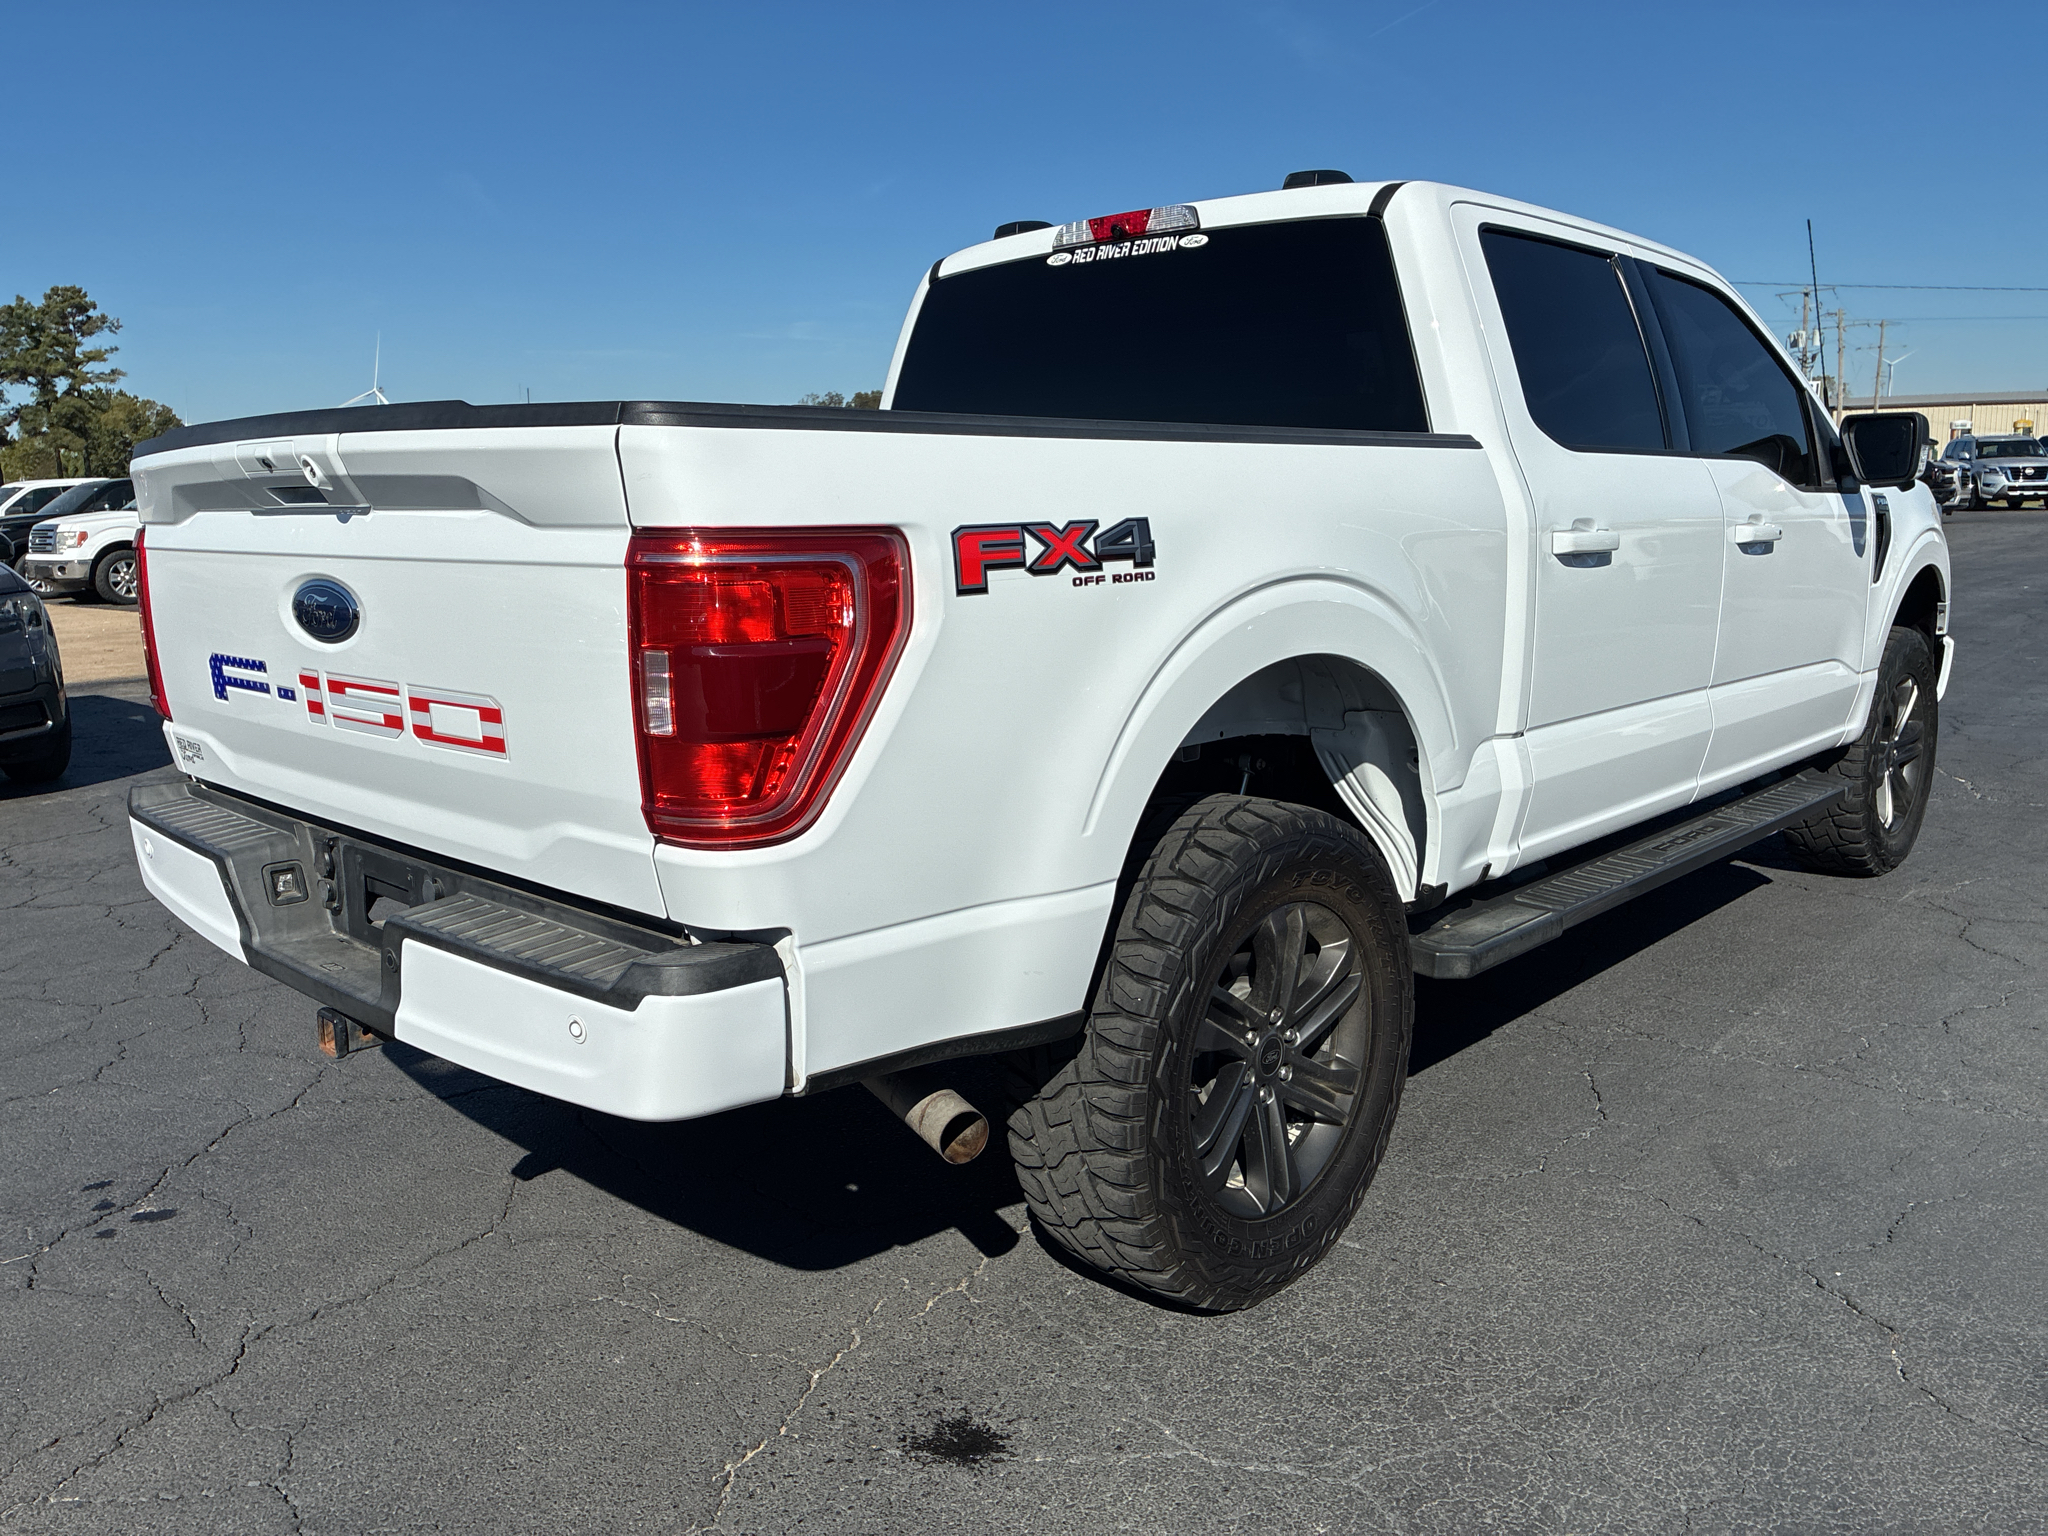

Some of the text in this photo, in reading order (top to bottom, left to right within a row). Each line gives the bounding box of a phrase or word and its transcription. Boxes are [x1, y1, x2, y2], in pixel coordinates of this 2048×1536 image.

[1072, 247, 1096, 264] RED
[1096, 242, 1131, 261] RIVER
[1131, 235, 1179, 256] EDITION
[950, 517, 1156, 597] FX4
[1072, 571, 1156, 587] OFF ROAD
[303, 593, 339, 630] Ford
[209, 652, 510, 762] F-150
[1651, 825, 1723, 852] FORD
[1291, 868, 1366, 904] TOYO
[1265, 1051, 1279, 1063] Ford
[1250, 1213, 1319, 1259] OPEN
